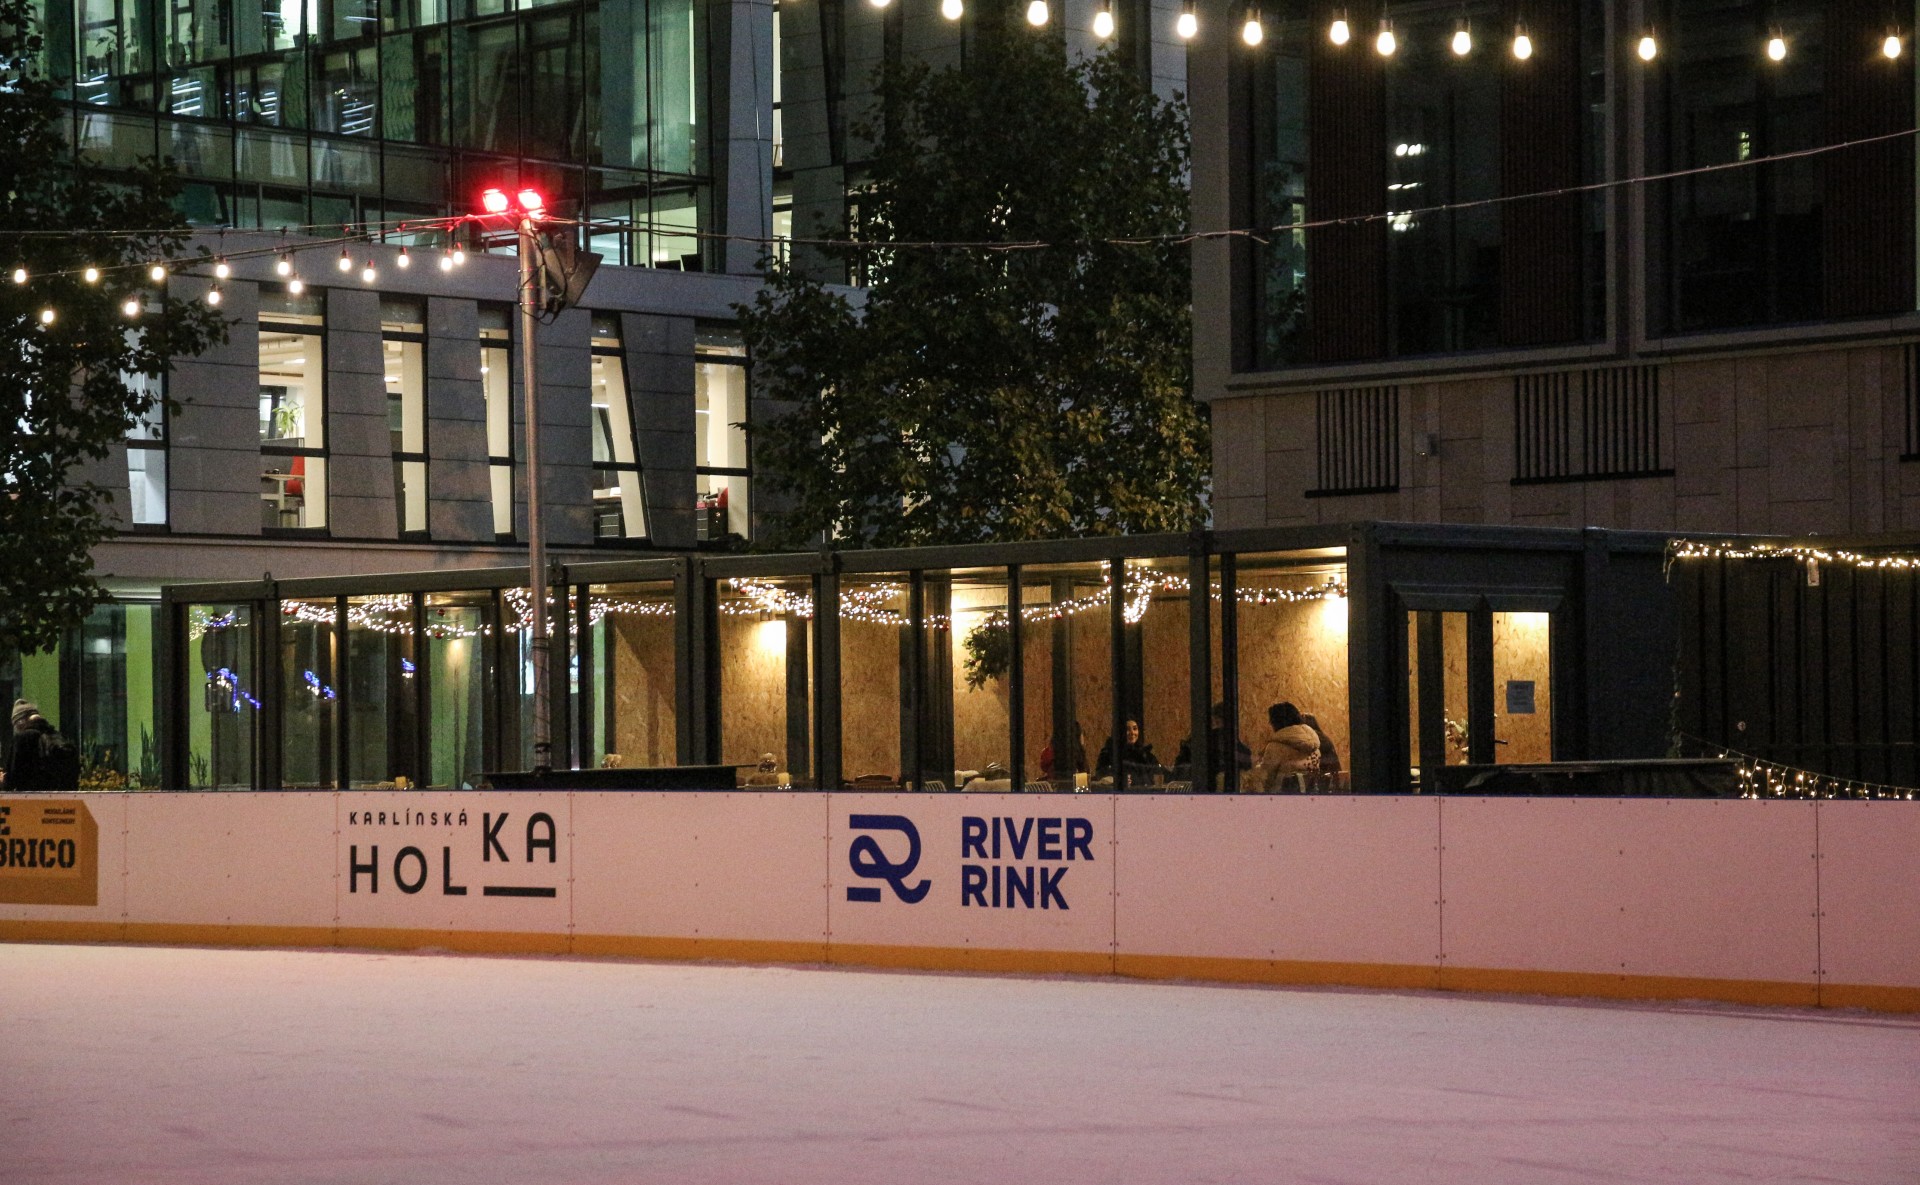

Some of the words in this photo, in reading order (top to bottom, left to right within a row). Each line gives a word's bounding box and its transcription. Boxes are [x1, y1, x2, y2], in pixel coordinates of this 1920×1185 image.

[350, 808, 468, 826] KARLÍNSKÁ
[962, 816, 1094, 860] RIVER
[962, 865, 1069, 909] RINK
